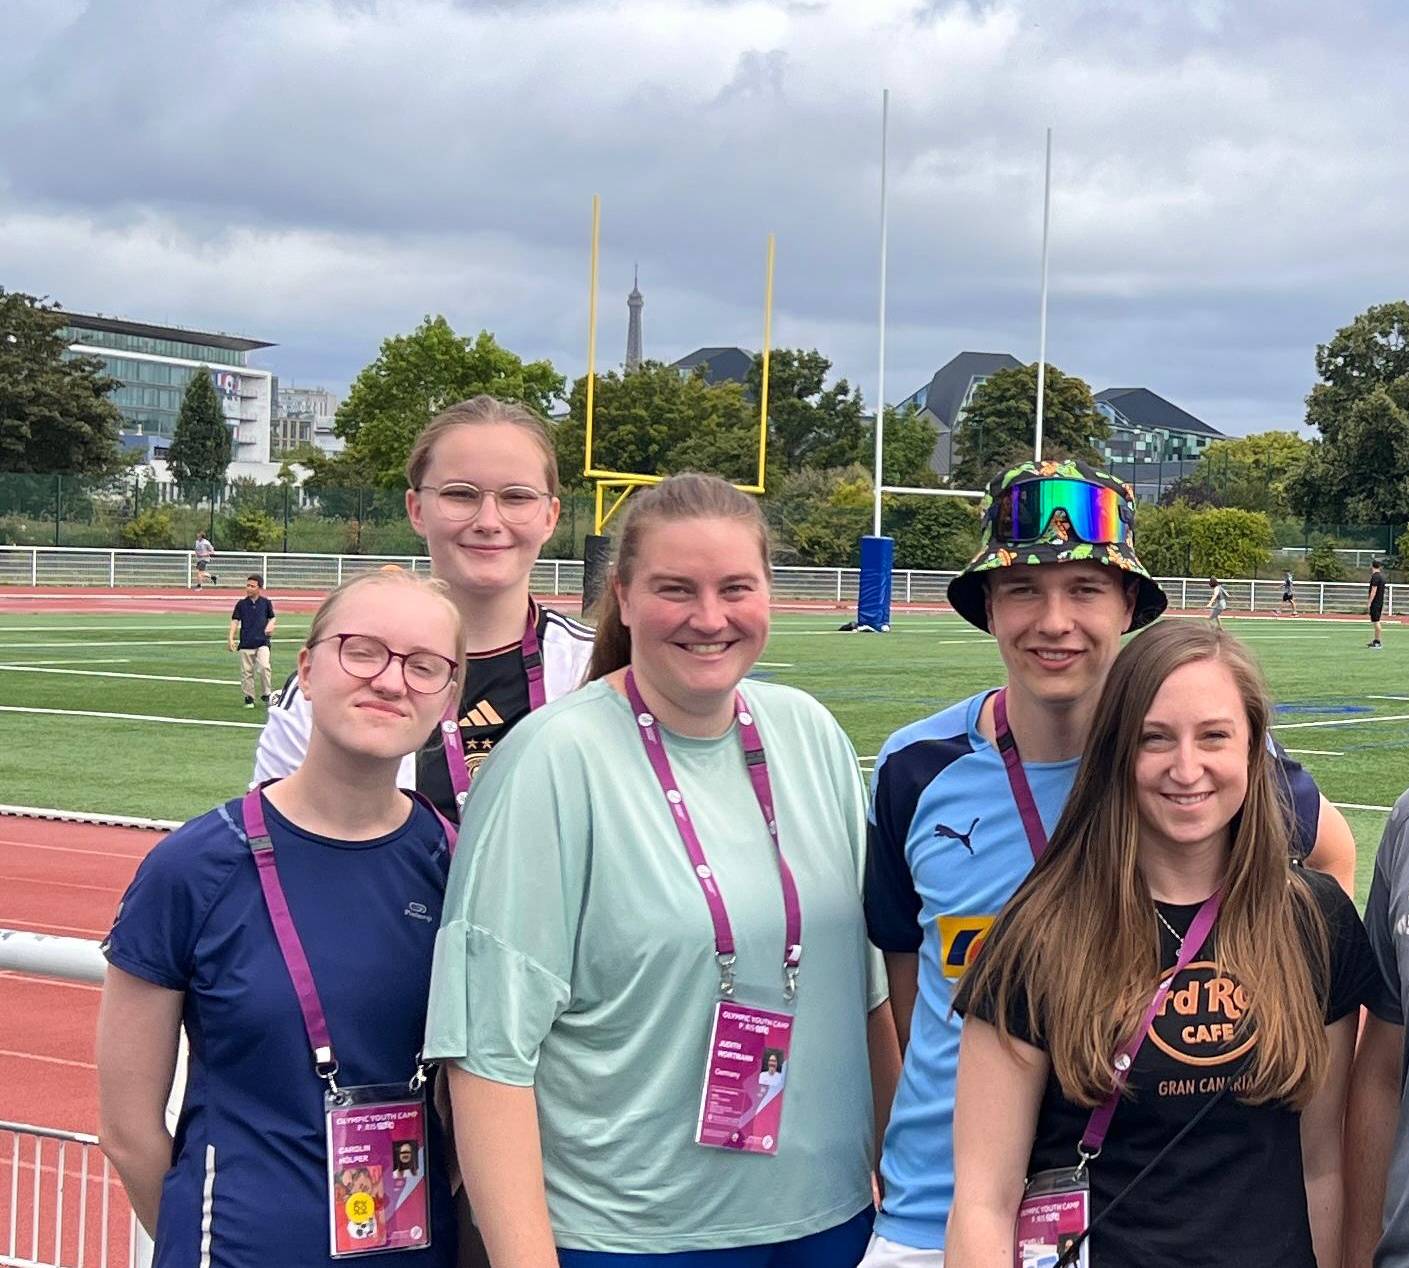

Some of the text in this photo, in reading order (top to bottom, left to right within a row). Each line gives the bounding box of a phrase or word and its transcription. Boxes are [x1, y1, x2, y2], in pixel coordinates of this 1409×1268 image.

[1156, 977, 1250, 1020] rd Ro
[1181, 1023, 1235, 1044] CAFE
[1158, 1080, 1195, 1096] GRAN
